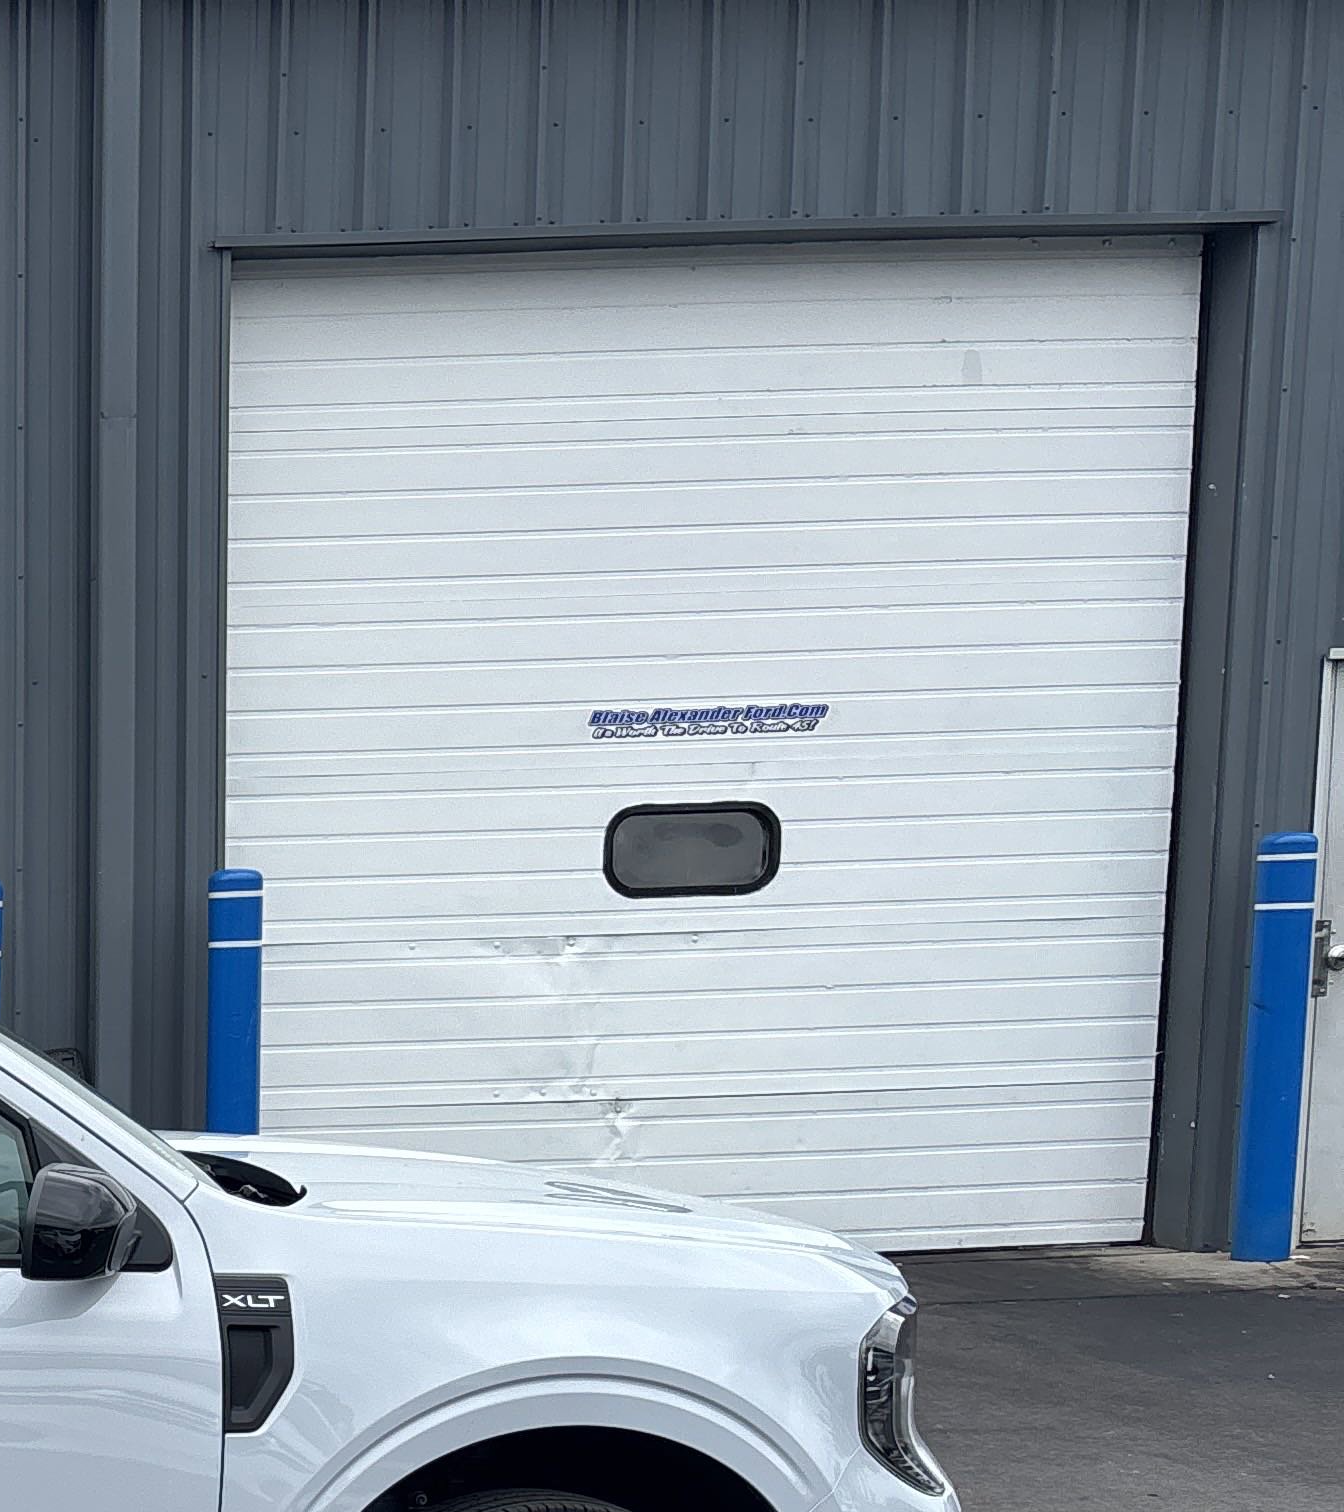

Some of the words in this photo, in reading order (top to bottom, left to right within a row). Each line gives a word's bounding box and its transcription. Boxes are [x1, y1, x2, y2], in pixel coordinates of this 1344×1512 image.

[589, 710, 649, 725] Blaise
[649, 706, 743, 724] Alexander
[660, 725, 686, 736] The
[687, 724, 727, 735] Drive
[728, 722, 748, 734] To
[749, 721, 790, 733] Route
[222, 1294, 285, 1308] XLT
